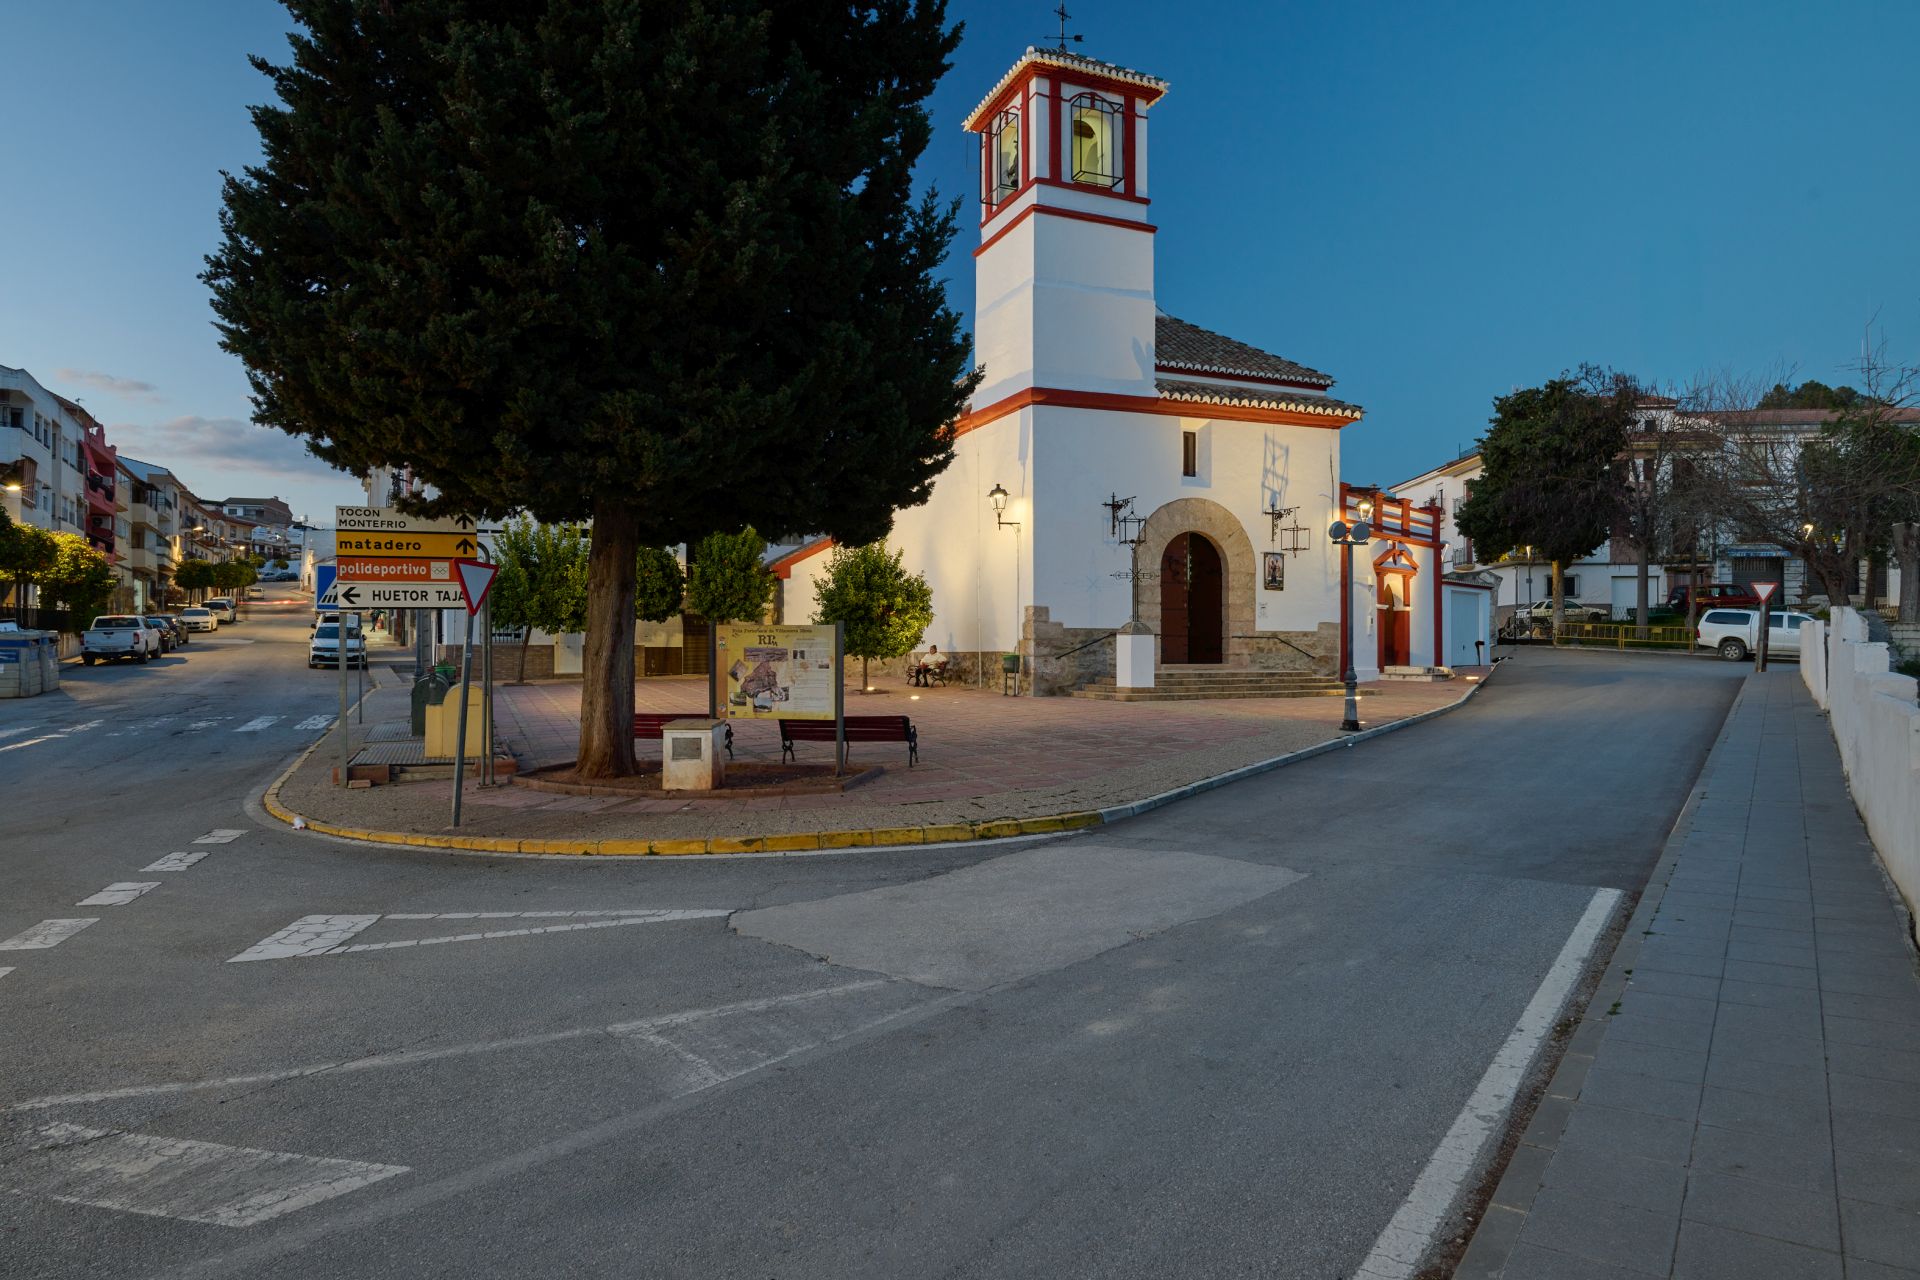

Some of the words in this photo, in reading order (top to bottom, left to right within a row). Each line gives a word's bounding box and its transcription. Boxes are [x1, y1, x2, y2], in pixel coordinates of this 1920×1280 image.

[339, 508, 380, 517] TOCON
[339, 519, 407, 528] MONTEFRIO
[339, 539, 422, 550] matadero
[339, 562, 427, 576] polideportivo
[372, 590, 428, 602] HUETOR
[435, 590, 466, 602] TAJA
